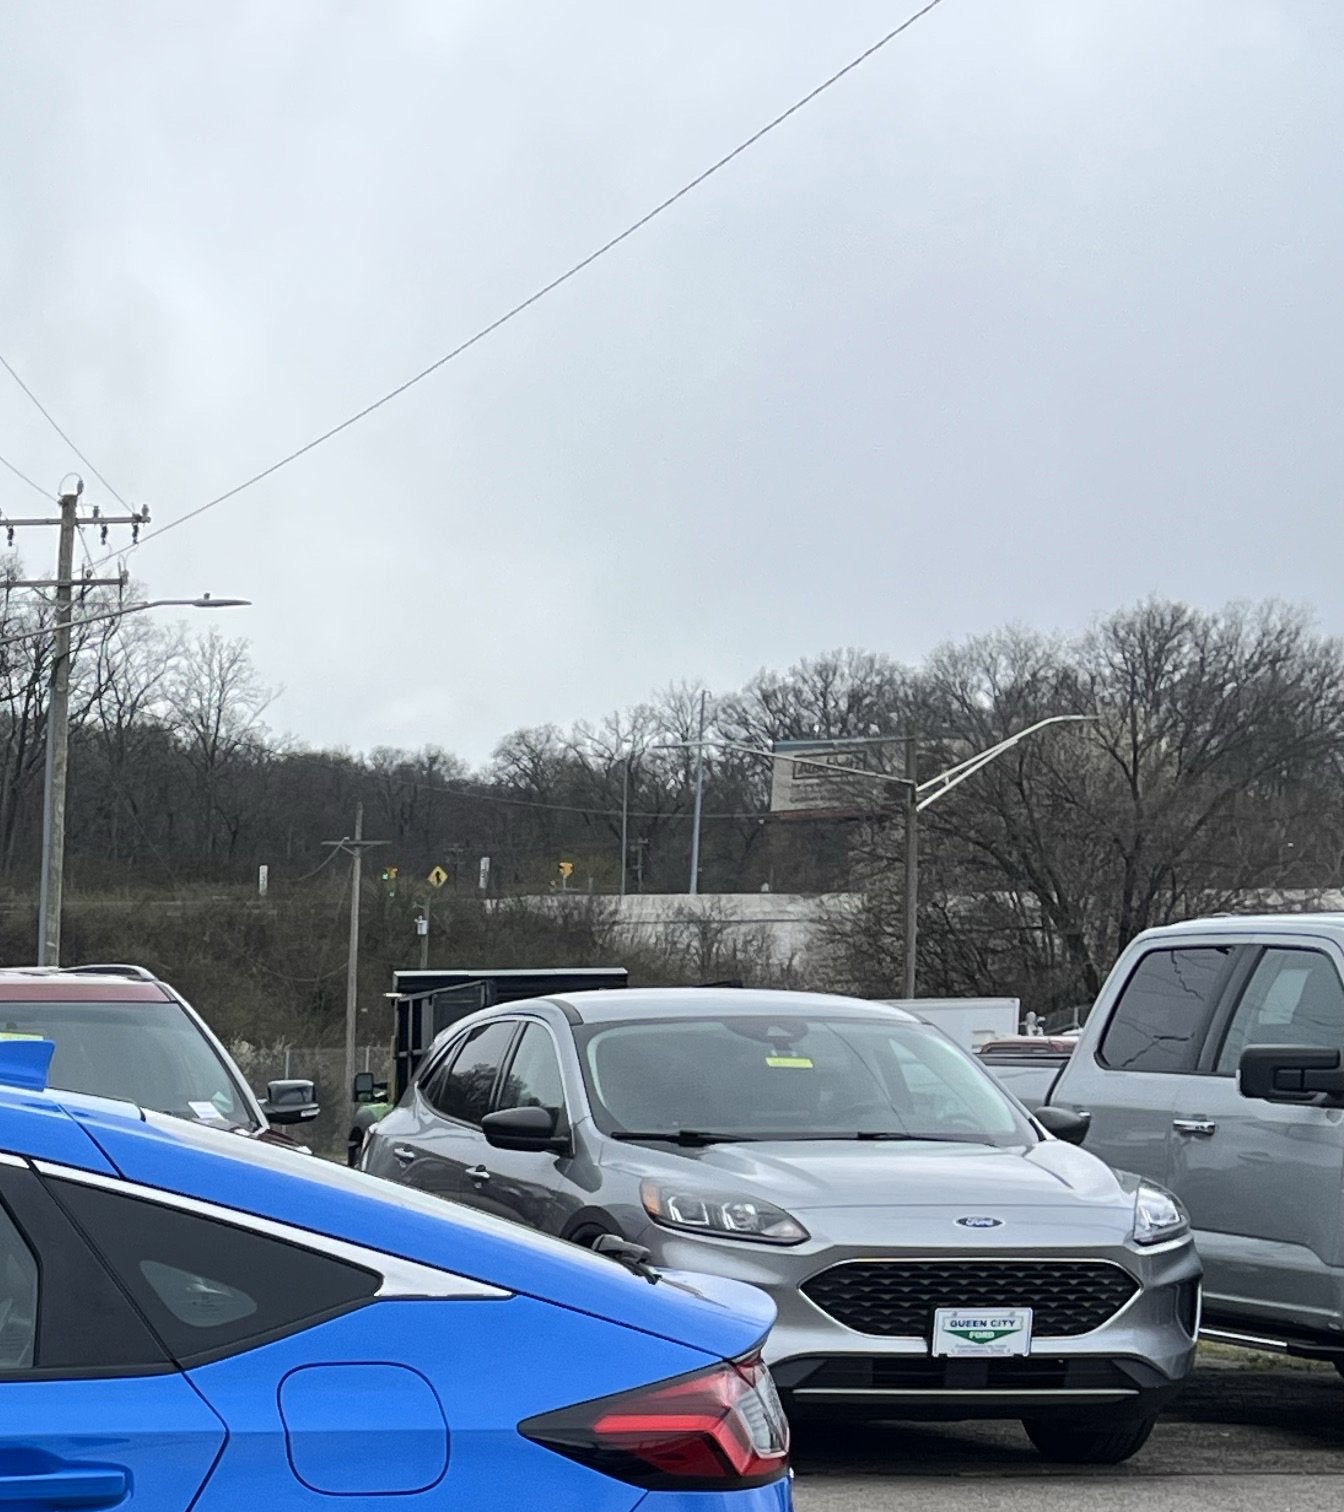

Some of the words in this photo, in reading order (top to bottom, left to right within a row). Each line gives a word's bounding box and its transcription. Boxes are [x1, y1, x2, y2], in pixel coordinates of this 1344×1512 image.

[949, 1319, 987, 1328] QUEEN
[990, 1319, 1016, 1328] CITY
[969, 1331, 995, 1340] FORD
